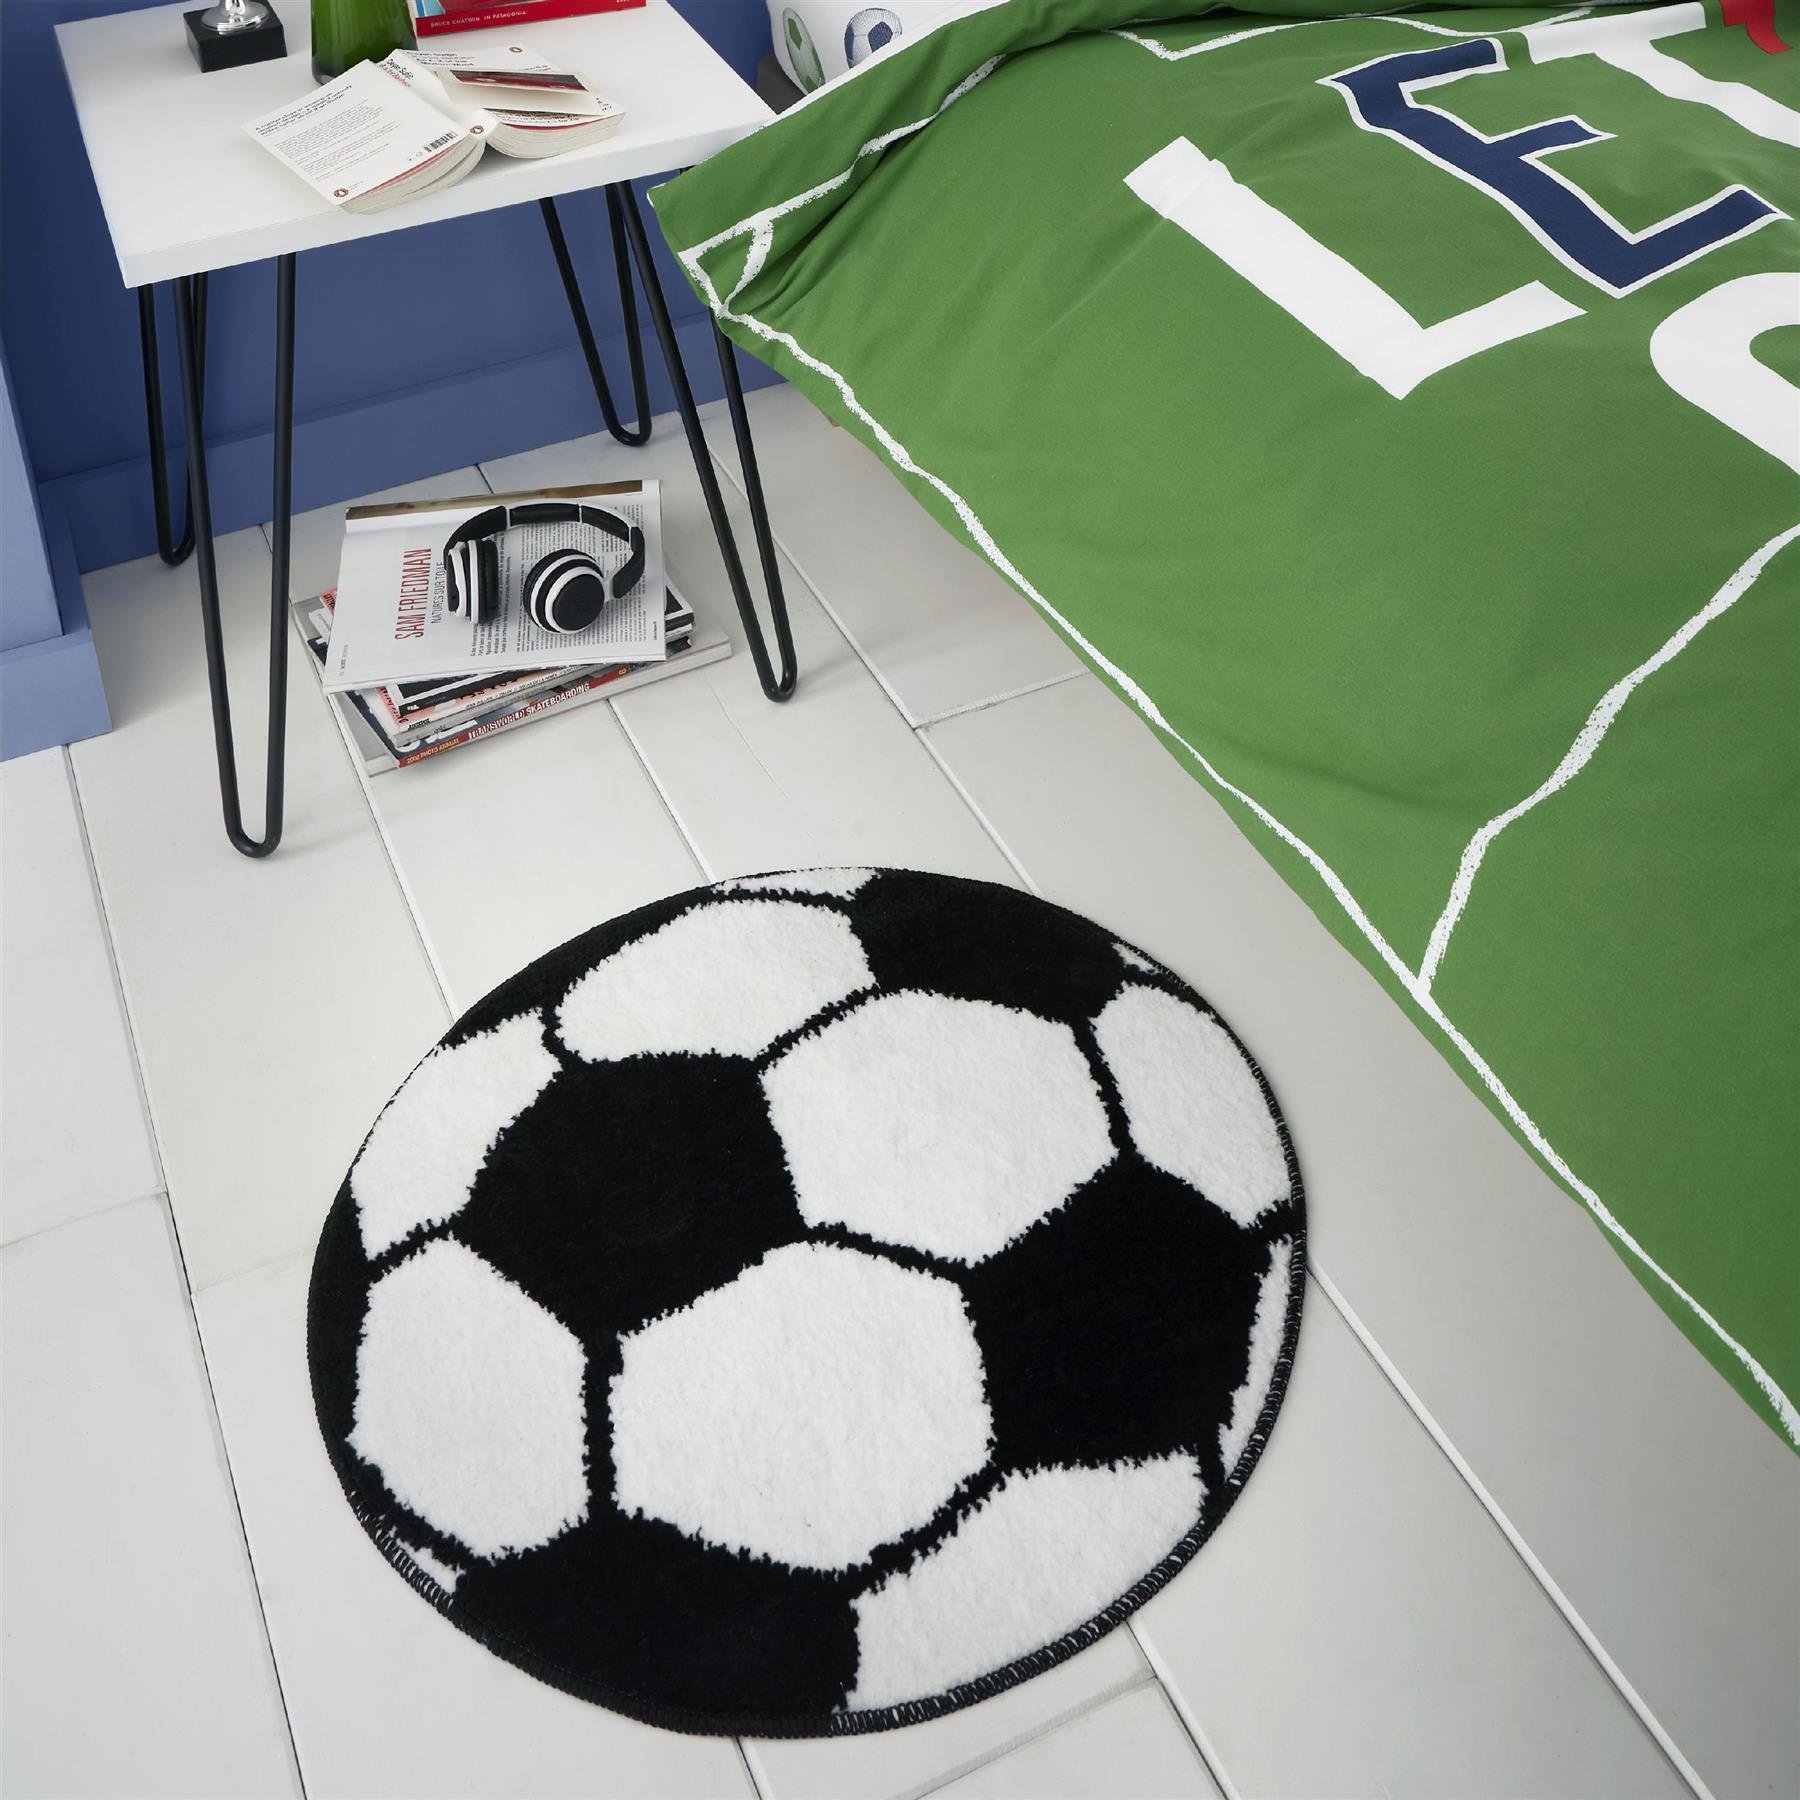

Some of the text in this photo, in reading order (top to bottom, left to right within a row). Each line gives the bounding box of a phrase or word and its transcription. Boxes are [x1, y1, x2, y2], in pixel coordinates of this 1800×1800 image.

[430, 20, 450, 28] BRUCE
[452, 17, 481, 25] CHATWIN
[493, 10, 527, 20] PATAGONIA
[394, 548, 432, 640] SAM FRIEDMAN
[434, 581, 445, 595] SUR
[431, 595, 444, 624] NATURES
[420, 746, 439, 759] PHOTO
[468, 709, 526, 740] TRANSWORLD
[525, 682, 590, 716] SKATEBOARDING
